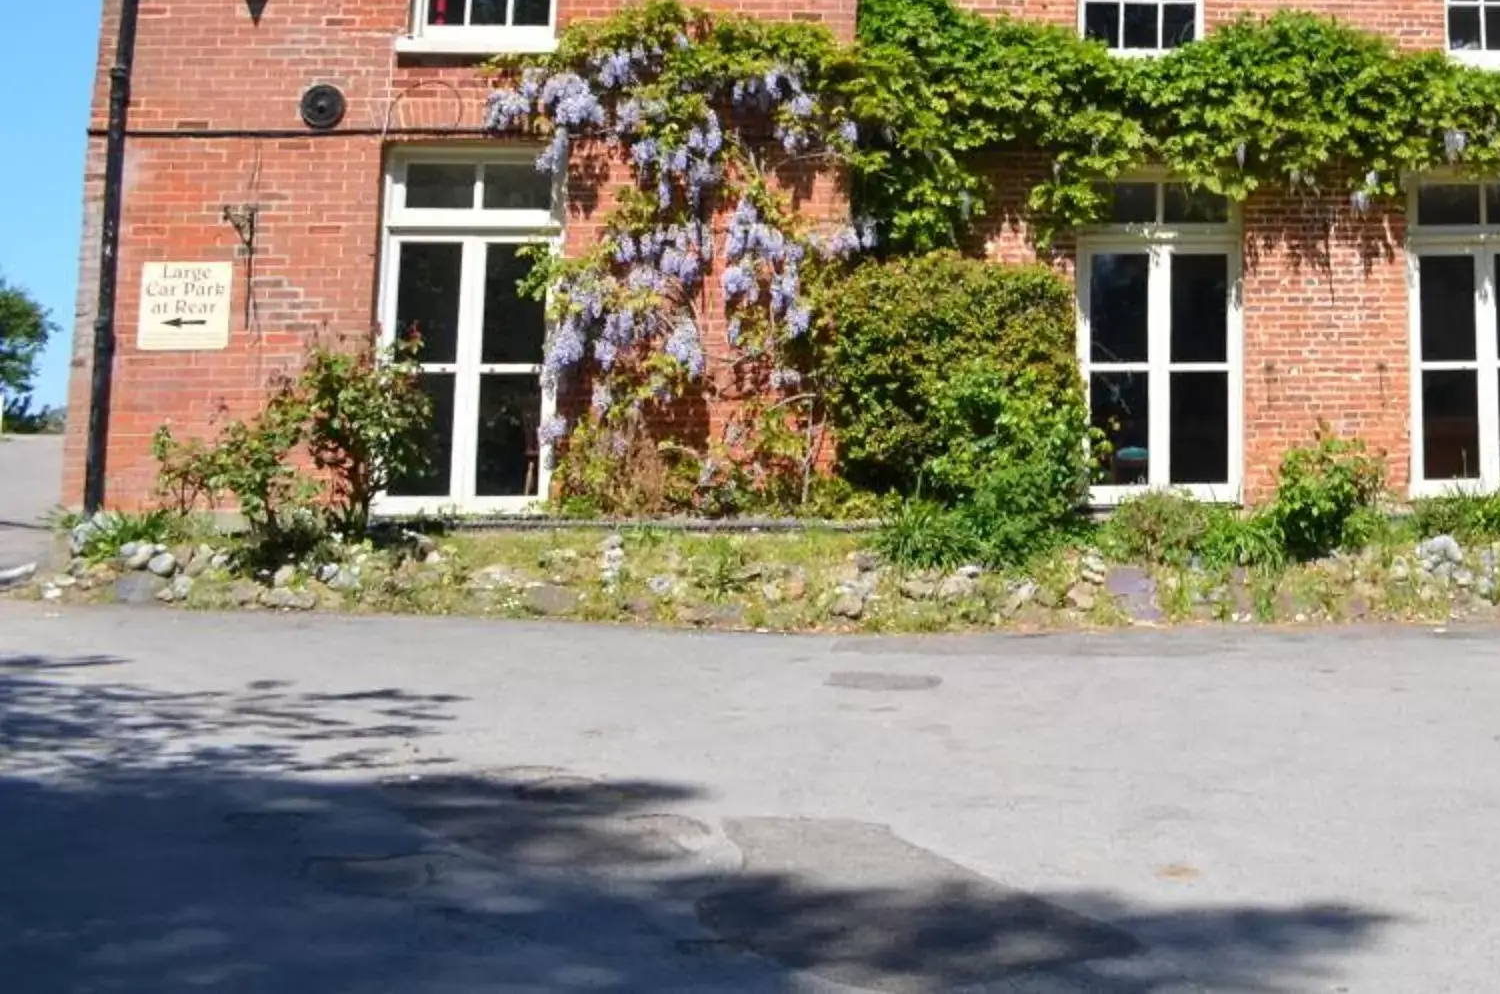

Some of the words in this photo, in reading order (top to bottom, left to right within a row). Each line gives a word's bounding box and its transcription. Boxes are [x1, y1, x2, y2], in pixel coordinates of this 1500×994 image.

[163, 264, 212, 281] Large
[146, 281, 176, 297] Car
[184, 282, 225, 298] Park
[150, 302, 168, 314] at
[175, 299, 216, 314] Rear
